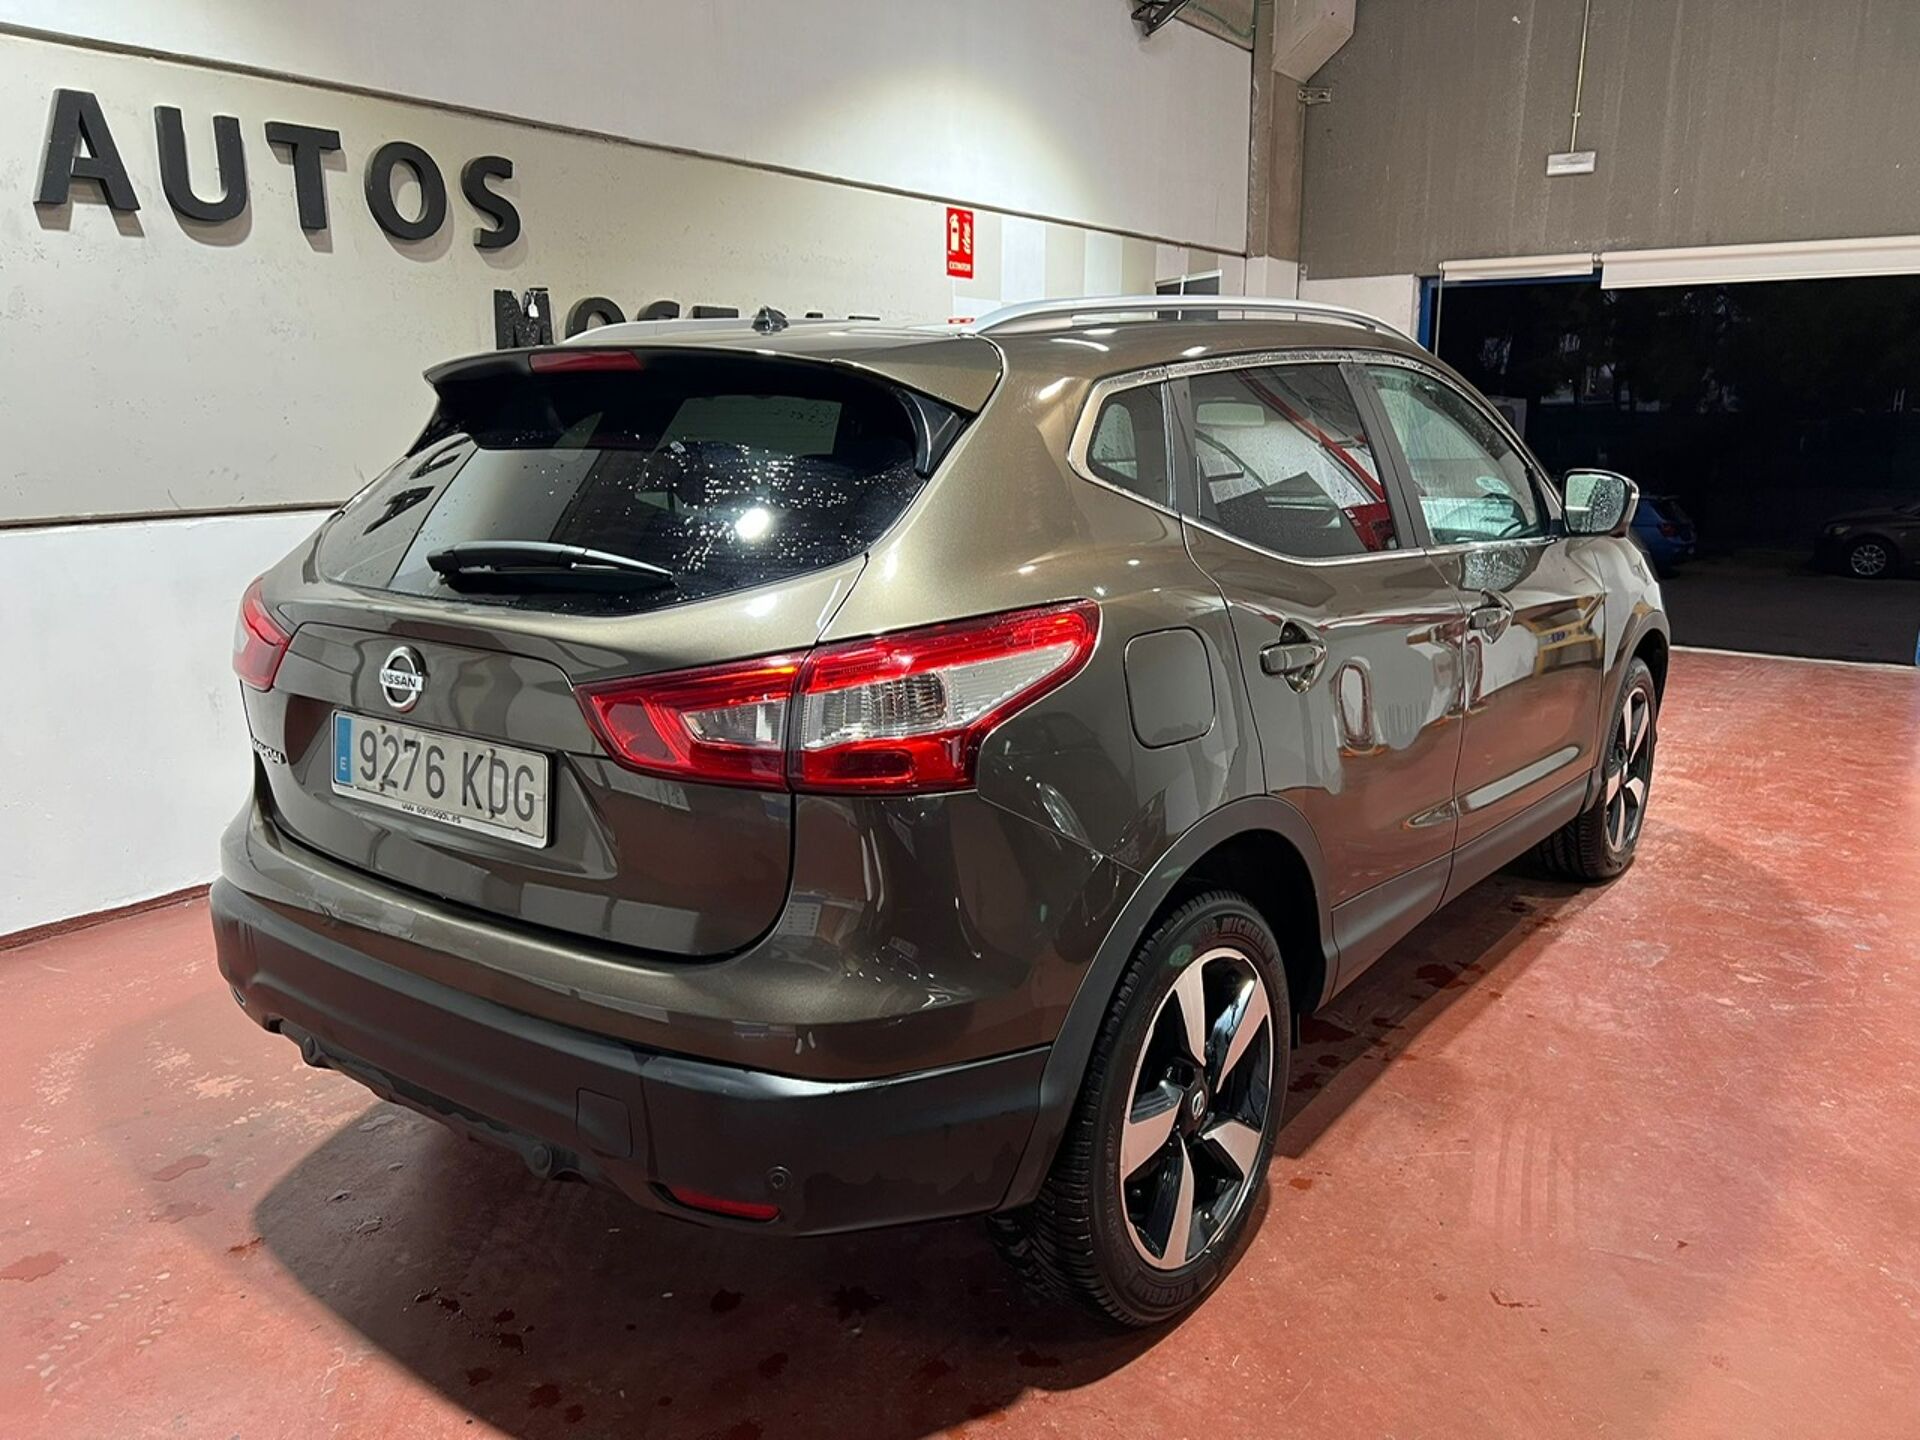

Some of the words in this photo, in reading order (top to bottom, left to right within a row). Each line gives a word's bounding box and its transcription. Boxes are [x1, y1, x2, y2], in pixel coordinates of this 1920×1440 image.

[33, 88, 521, 249] AUTOS
[382, 671, 417, 688] NISSAN
[339, 756, 347, 770] E
[360, 730, 445, 799] 9276
[462, 751, 535, 821] KDG
